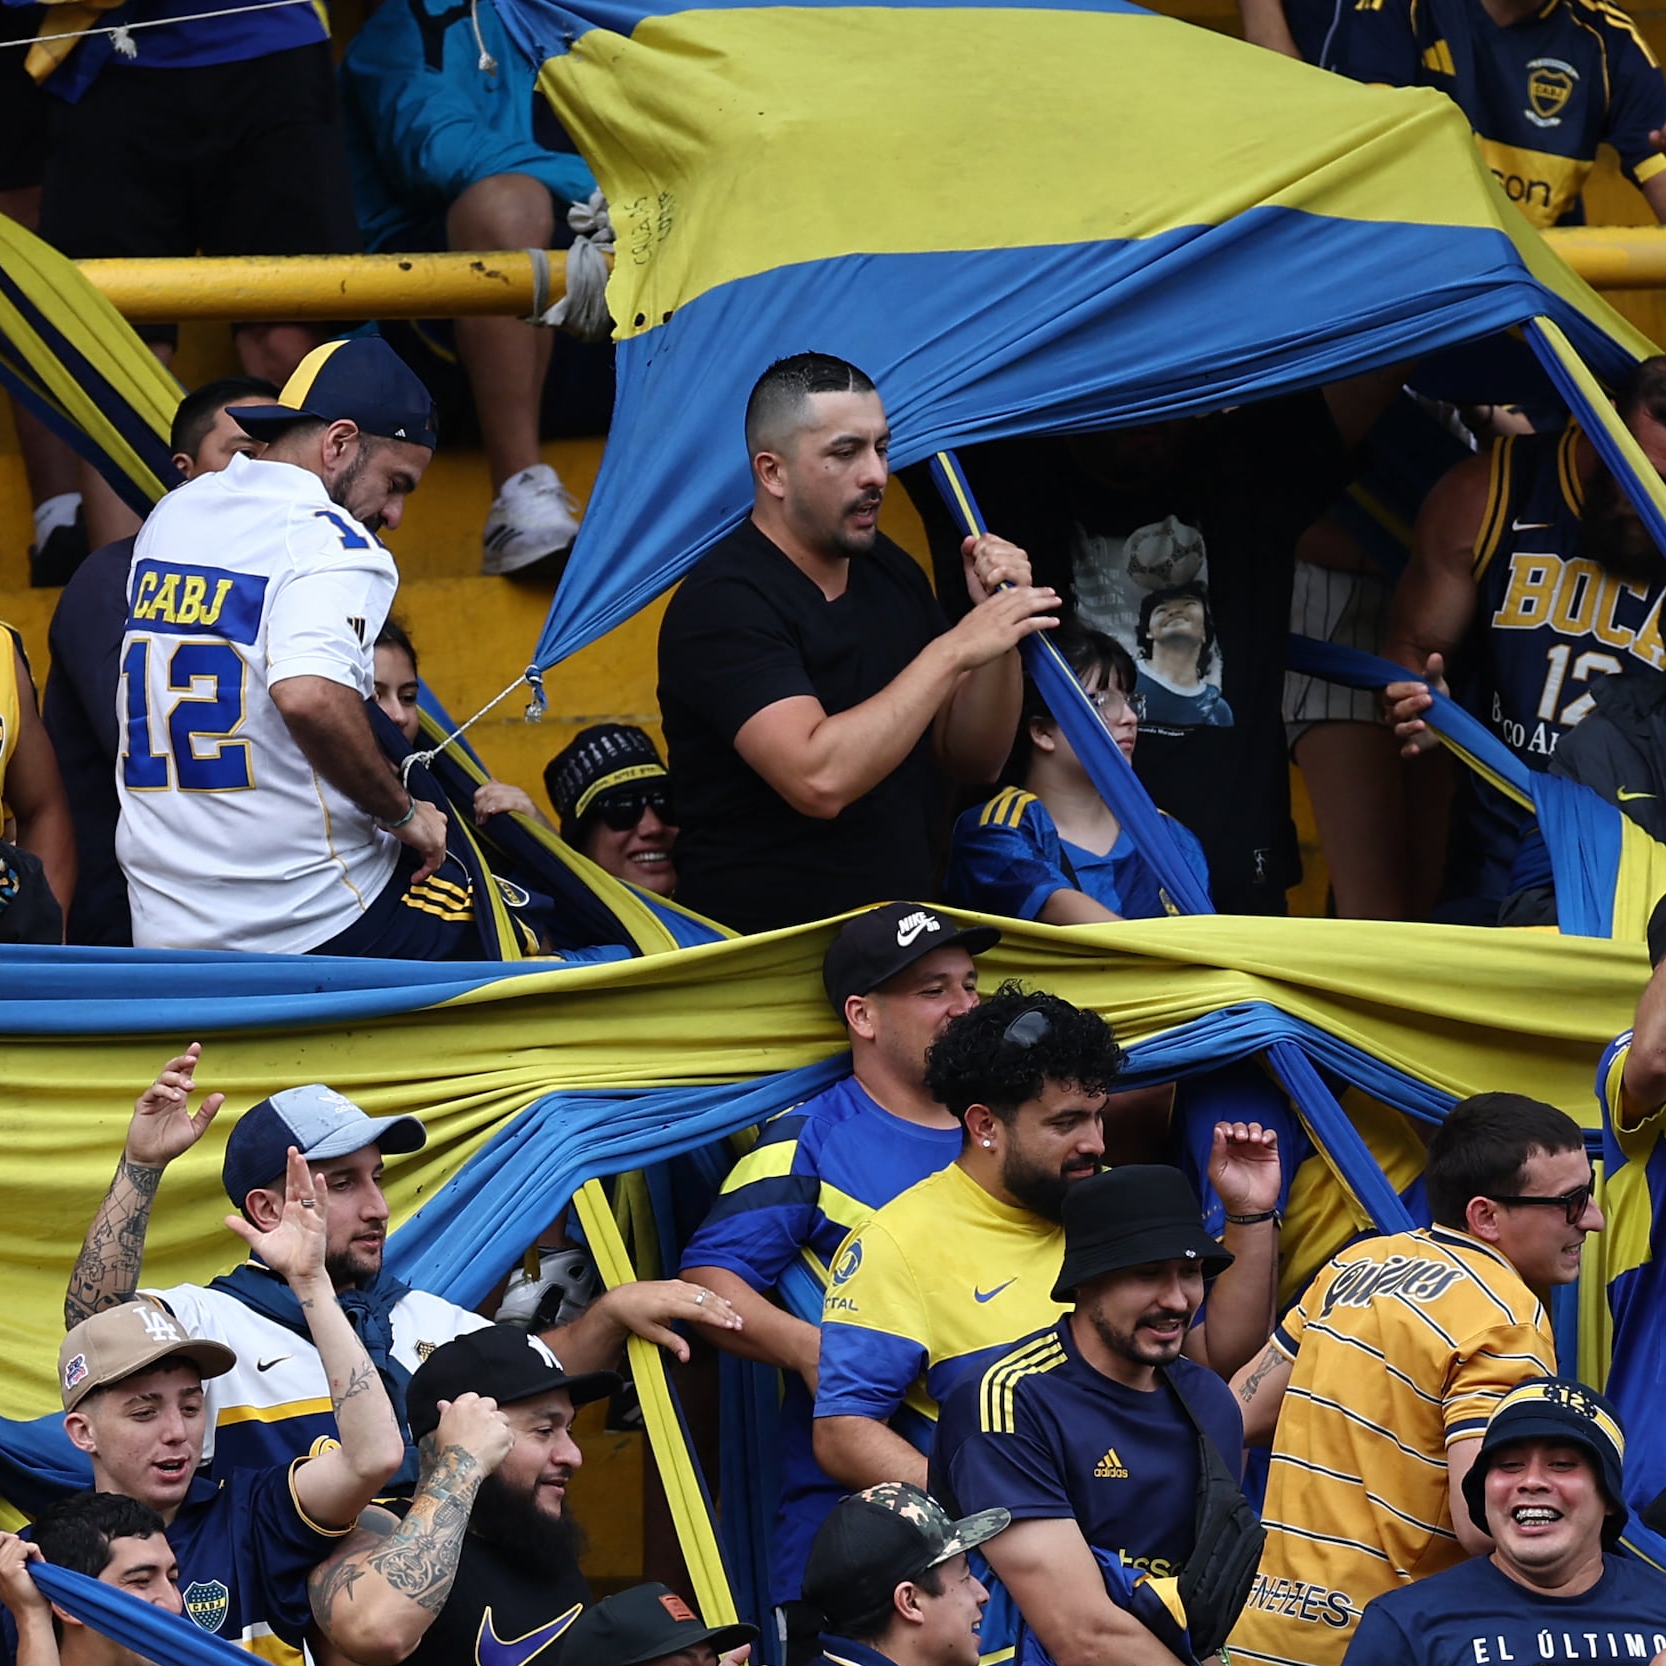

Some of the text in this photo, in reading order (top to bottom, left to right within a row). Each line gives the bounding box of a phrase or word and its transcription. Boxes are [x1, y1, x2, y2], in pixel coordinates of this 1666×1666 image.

[133, 571, 231, 625] CABJ
[120, 638, 256, 793] 12
[898, 911, 929, 934] NIKE
[826, 1297, 859, 1312] TAL
[133, 1306, 182, 1342] LA
[1558, 1389, 1585, 1414] 12
[1093, 1468, 1129, 1479] adidas
[192, 1600, 222, 1613] CABJ
[1253, 1572, 1351, 1629] NEIZES
[1473, 1630, 1666, 1665] EL ÚLTIMO
